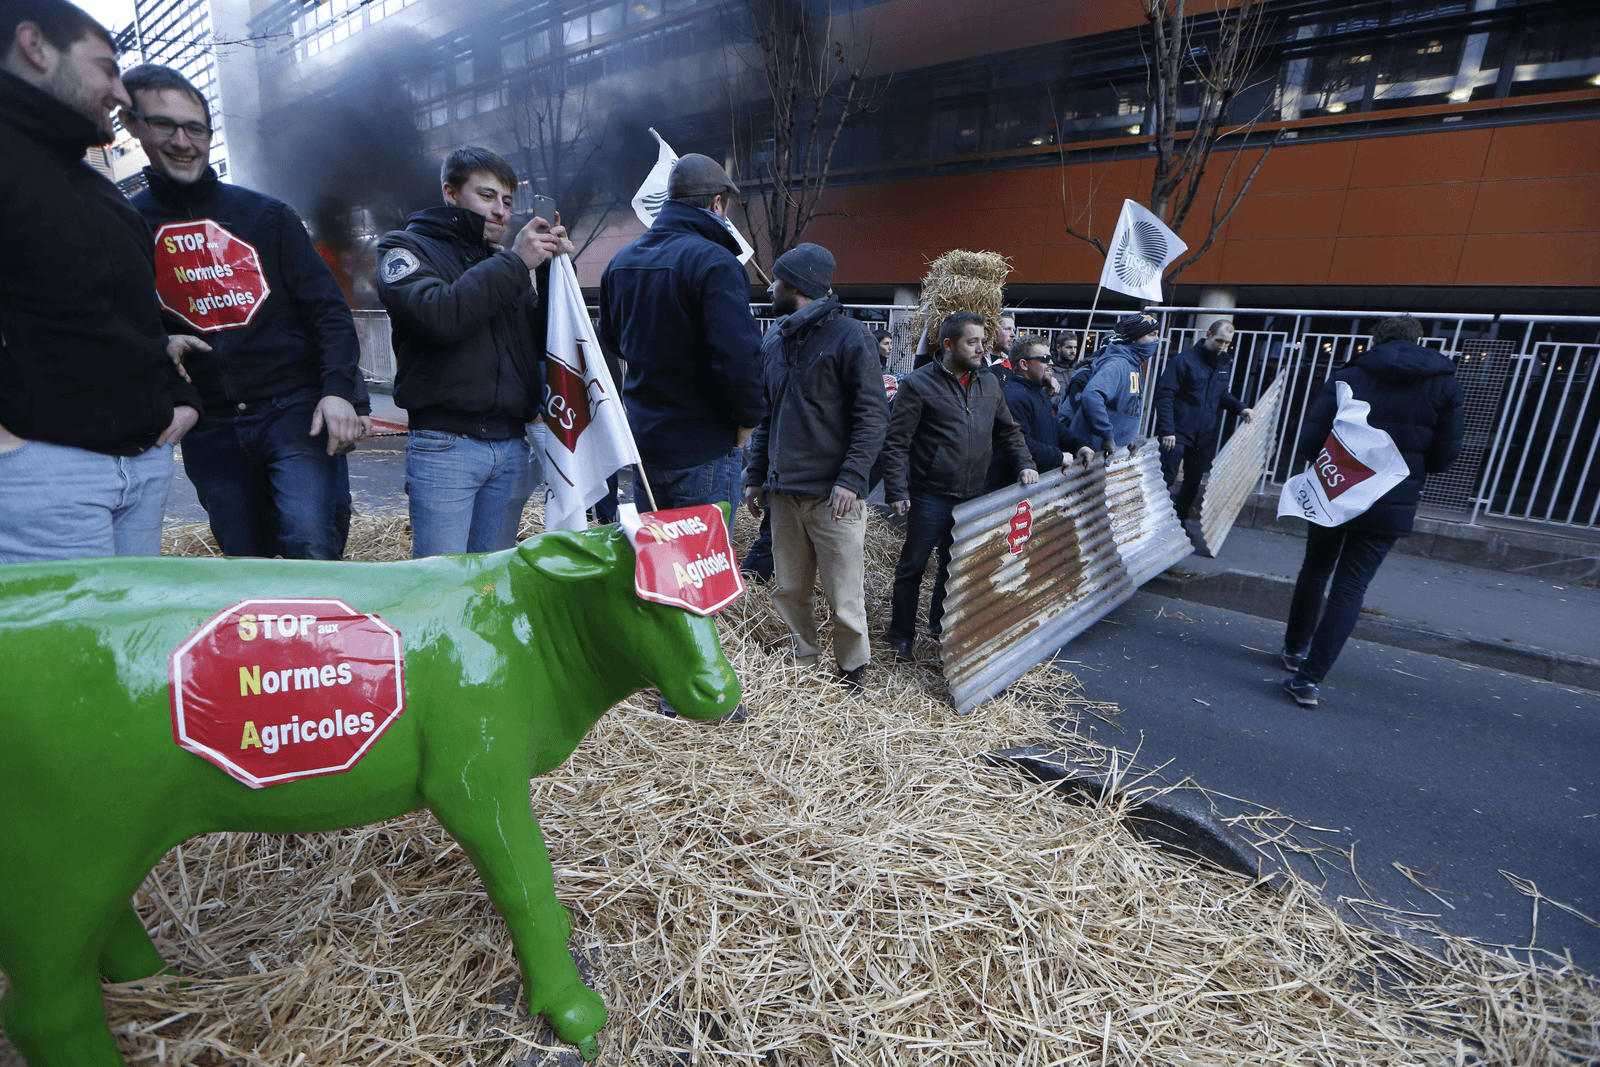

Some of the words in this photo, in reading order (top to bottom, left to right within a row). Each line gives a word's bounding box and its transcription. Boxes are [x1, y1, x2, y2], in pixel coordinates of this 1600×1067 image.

[164, 233, 205, 254] STOP
[174, 263, 234, 284] Normes
[188, 289, 255, 315] Agricoles
[1316, 447, 1346, 488] nes
[646, 516, 708, 545] Normes
[672, 549, 731, 589] Agricoles
[238, 614, 317, 641] STOP
[317, 622, 339, 634] aux
[239, 662, 352, 697] Normes
[240, 709, 375, 754] Agricoles
